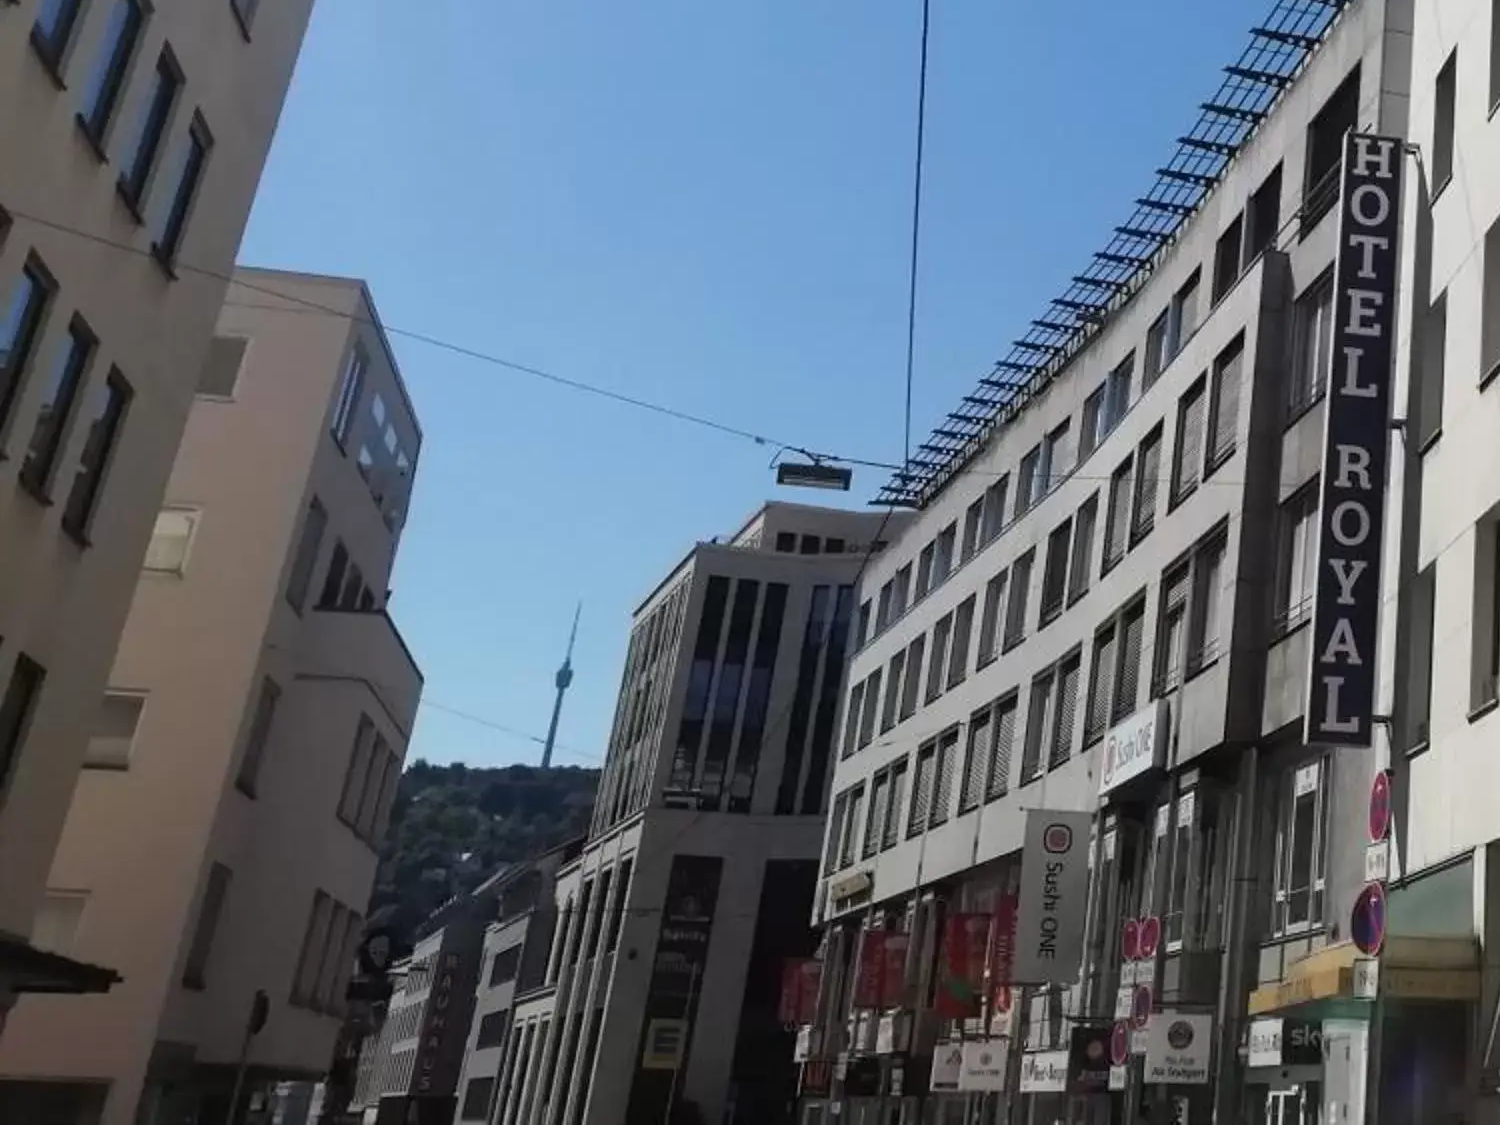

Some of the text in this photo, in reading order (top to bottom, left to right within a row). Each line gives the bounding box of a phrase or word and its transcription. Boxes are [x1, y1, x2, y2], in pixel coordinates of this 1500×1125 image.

[1321, 139, 1393, 733] HOTEL ROYAL
[1037, 862, 1063, 960] Sushi ONE
